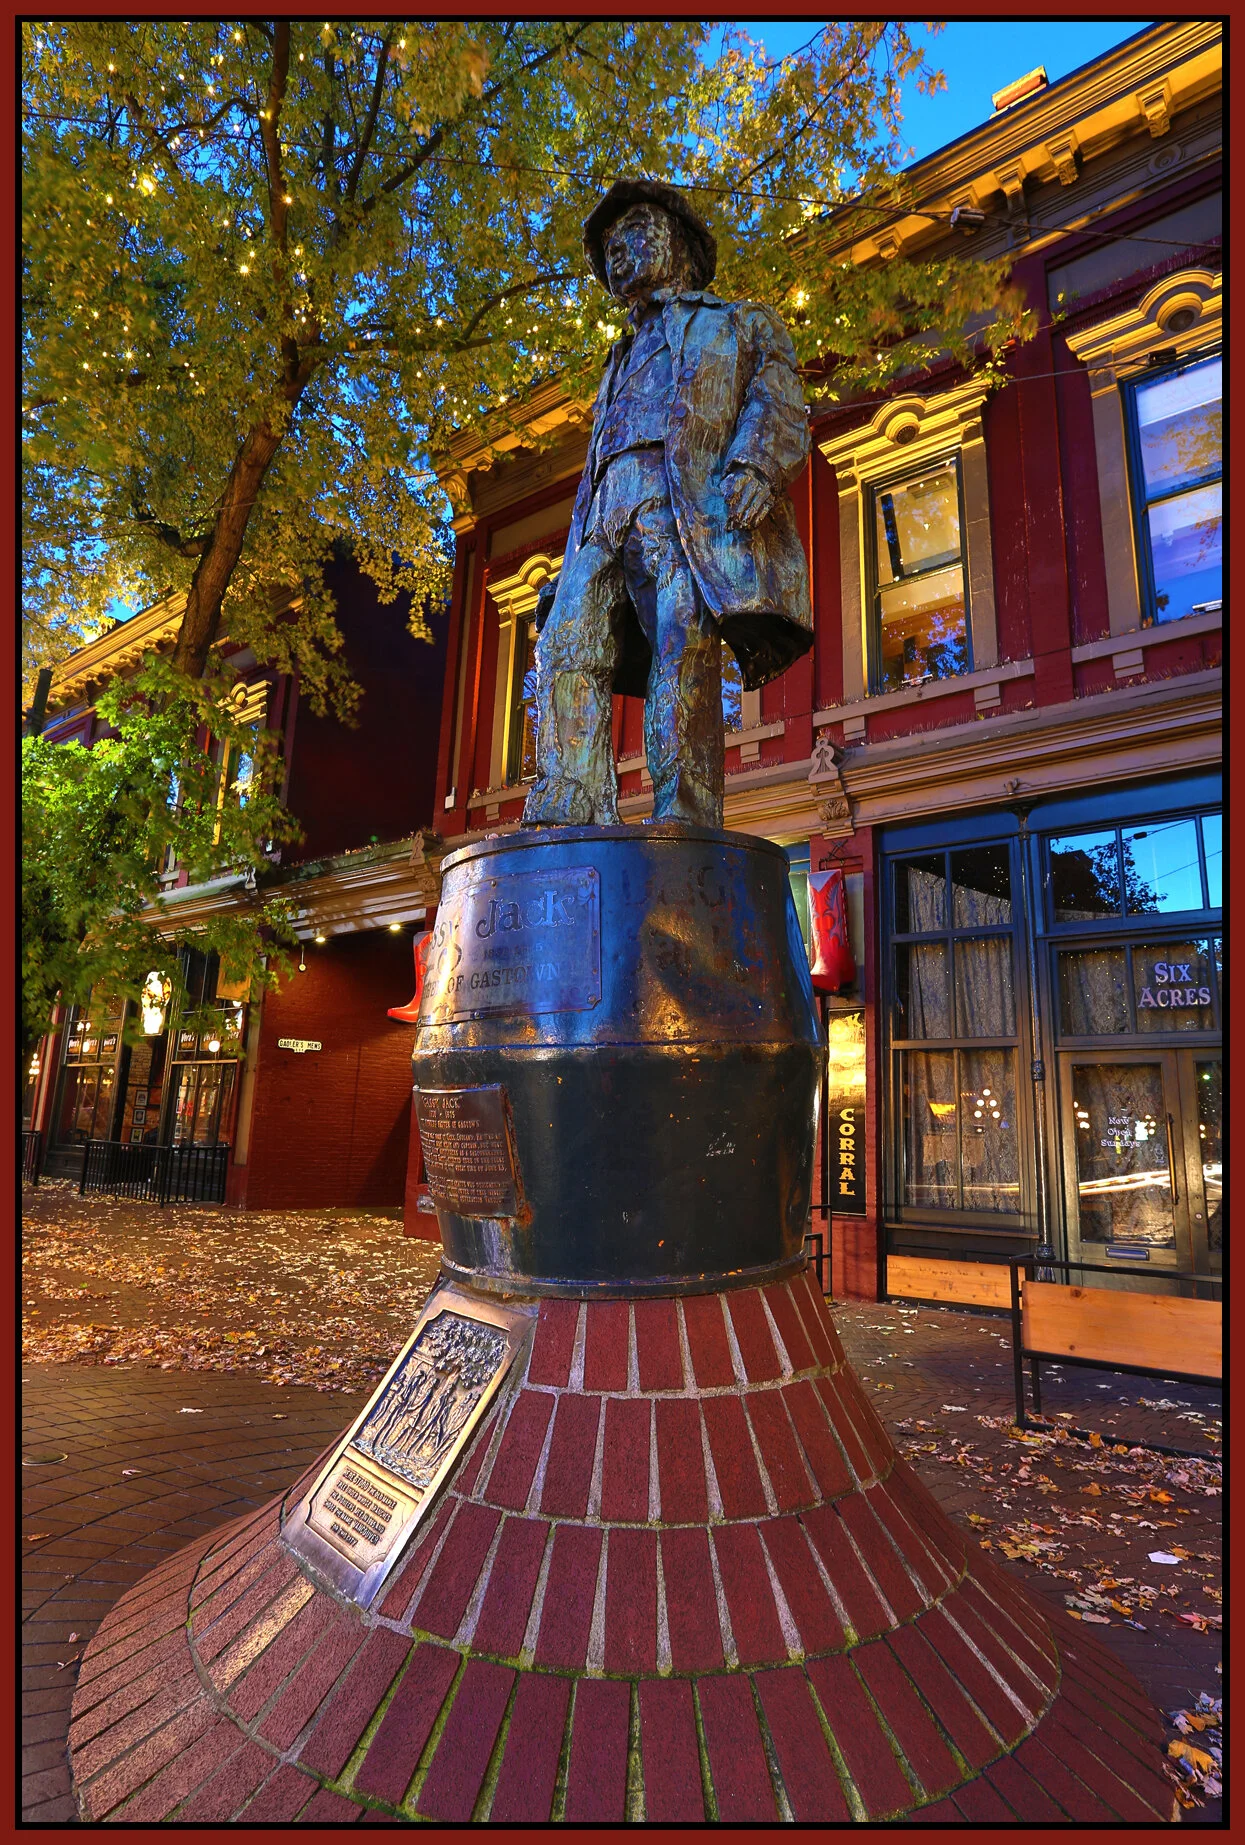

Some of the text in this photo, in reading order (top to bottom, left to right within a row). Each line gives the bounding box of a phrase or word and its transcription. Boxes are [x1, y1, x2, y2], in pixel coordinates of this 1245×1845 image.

[475, 890, 575, 940] Jack
[448, 975, 464, 995] OF
[470, 963, 561, 990] GASTOWN
[839, 1108, 856, 1196] CORRAL
